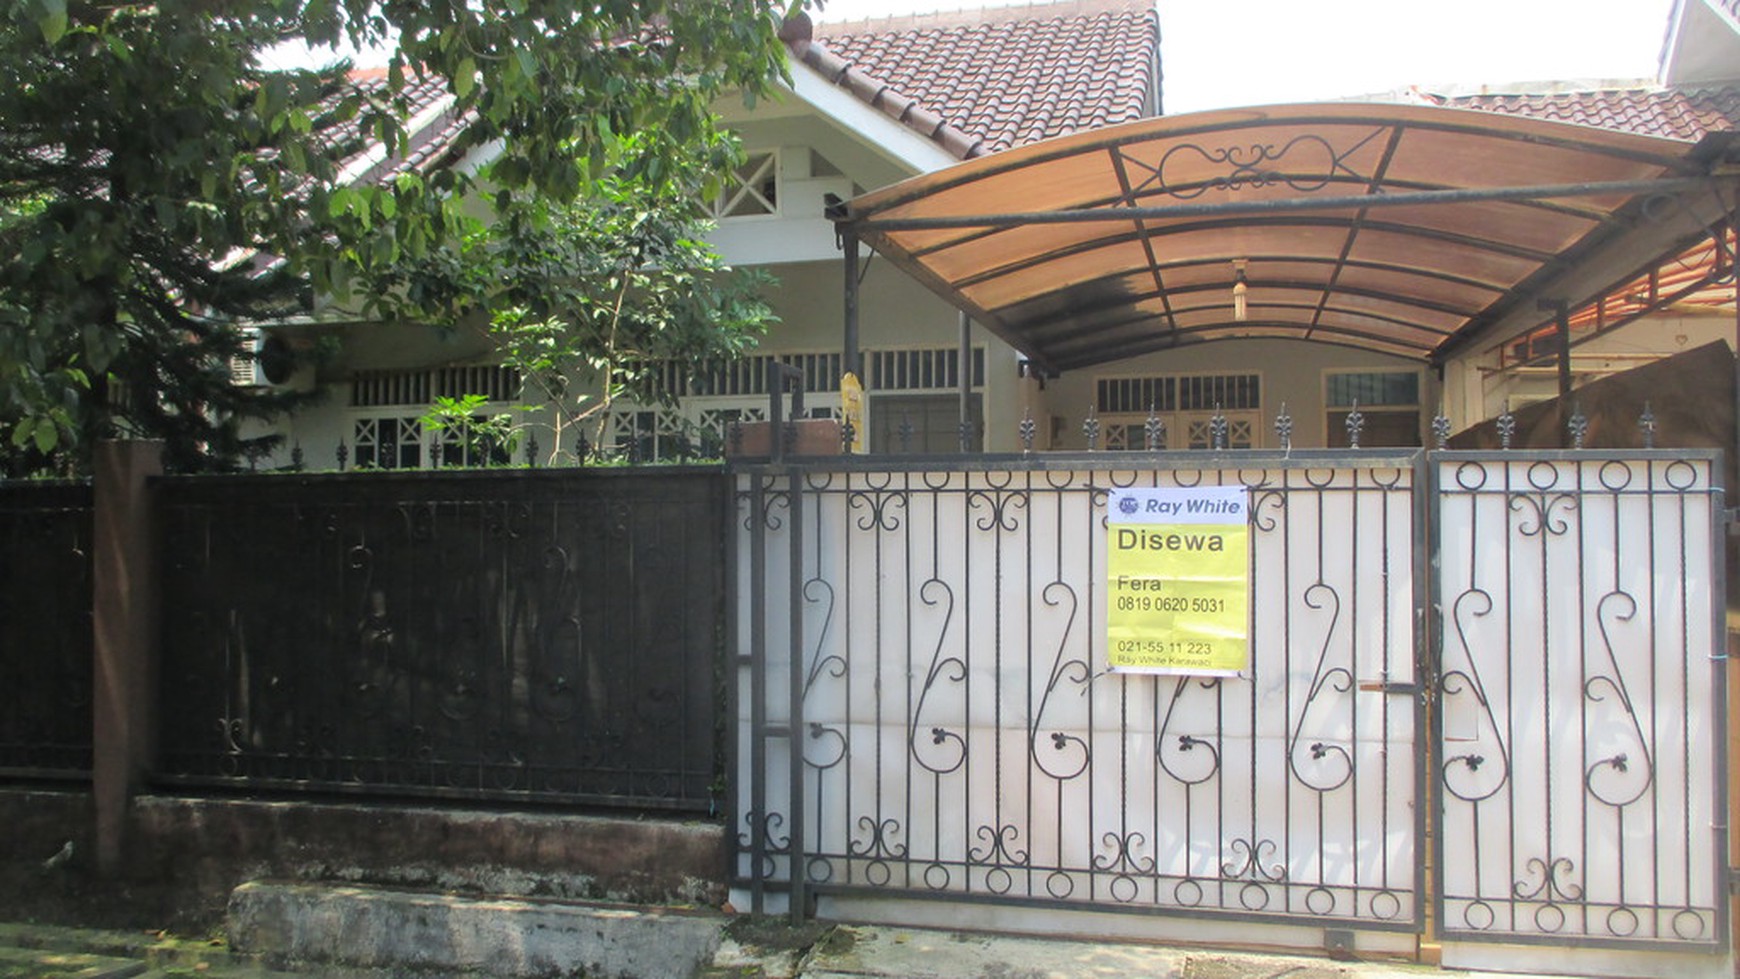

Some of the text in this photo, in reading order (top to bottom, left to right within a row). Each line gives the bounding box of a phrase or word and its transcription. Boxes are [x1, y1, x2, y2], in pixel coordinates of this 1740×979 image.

[1145, 499, 1240, 515] Ray White
[1118, 529, 1223, 551] Disewa
[1118, 576, 1161, 591] Fera
[1117, 596, 1225, 612] 0819 0620 5031
[1117, 641, 1212, 655] 021-55 11 223
